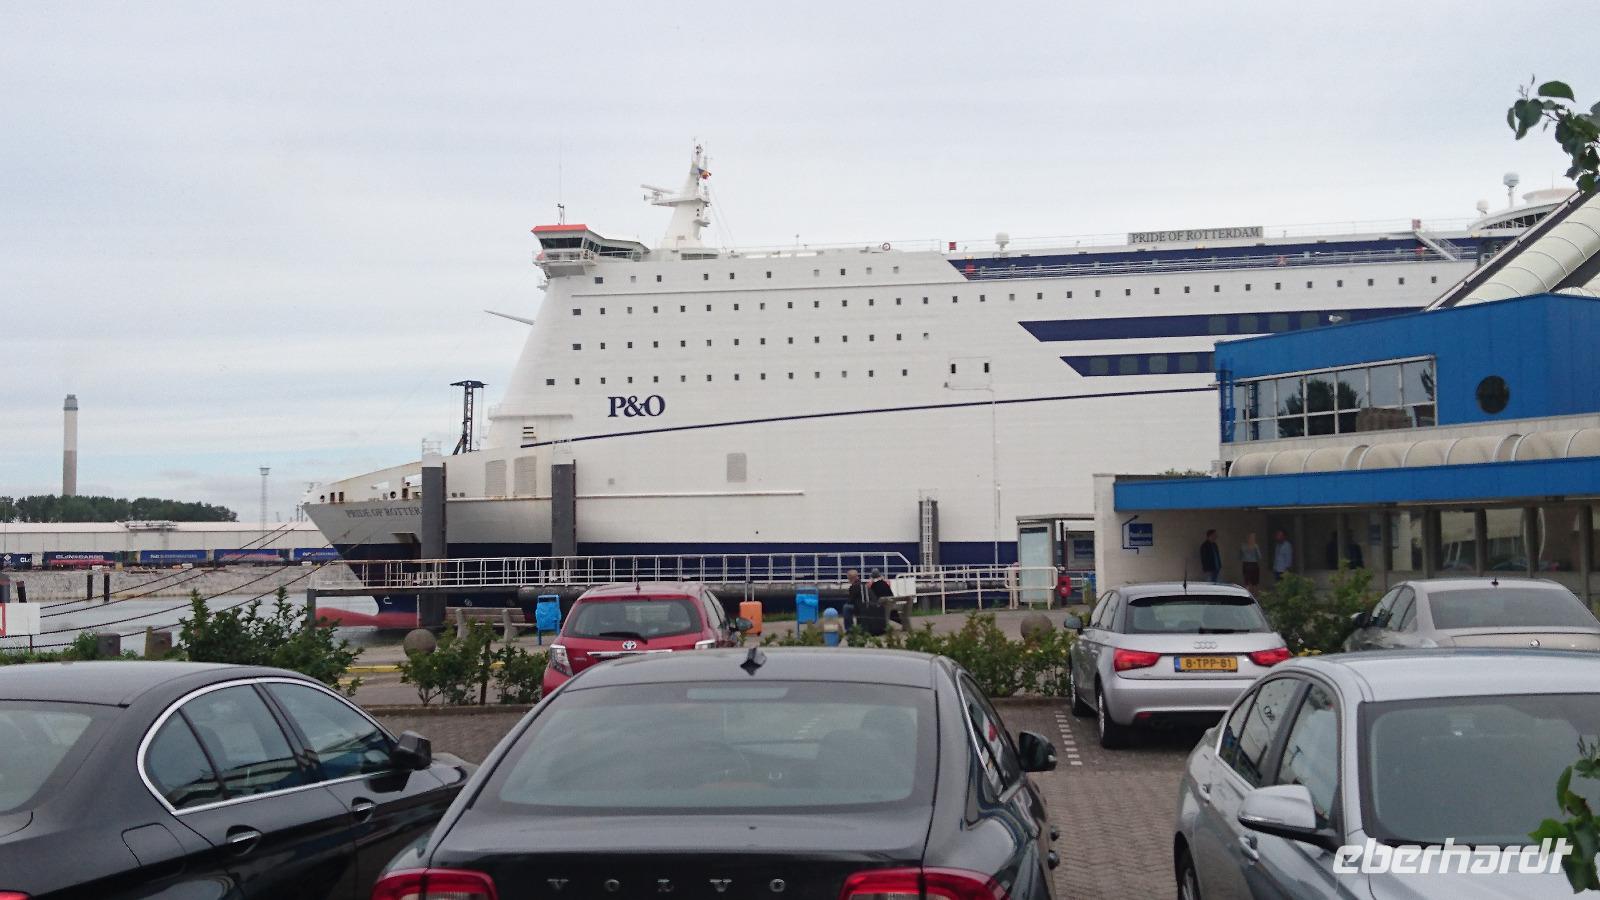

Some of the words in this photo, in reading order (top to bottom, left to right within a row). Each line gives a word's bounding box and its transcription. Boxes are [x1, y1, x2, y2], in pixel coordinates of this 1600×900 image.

[1132, 232, 1166, 244] PRIDE
[1168, 231, 1184, 241] OF
[1187, 227, 1260, 240] ROTTERDAM
[607, 394, 666, 418] P&O
[384, 506, 424, 517] ROTTER
[547, 878, 786, 893] VOLVO
